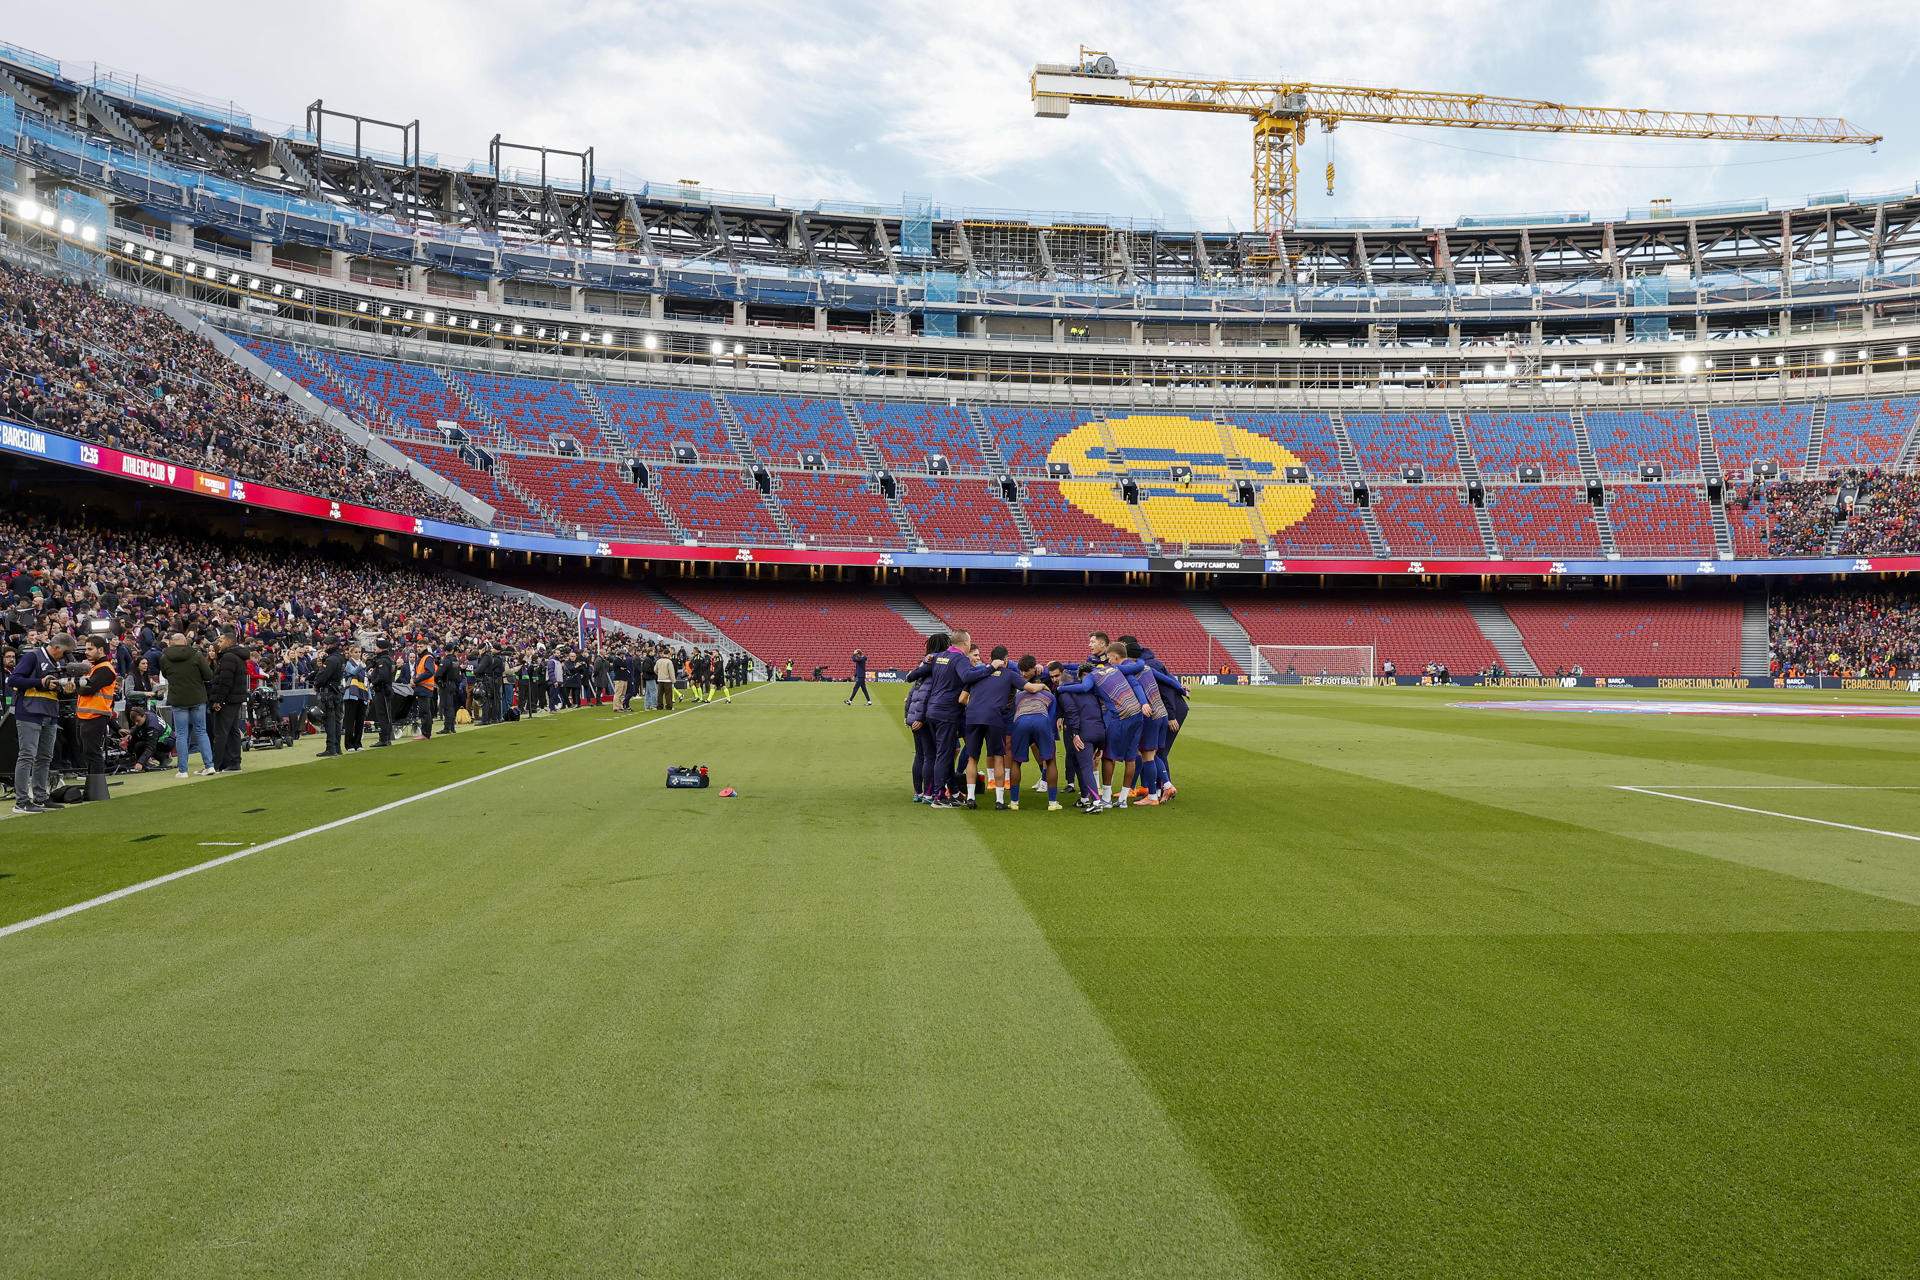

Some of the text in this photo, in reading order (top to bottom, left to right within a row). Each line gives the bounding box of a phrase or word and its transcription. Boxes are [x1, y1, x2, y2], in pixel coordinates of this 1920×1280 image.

[2, 424, 46, 454] BARCELONA
[122, 455, 166, 481] ATHLETIC CLUB
[1183, 561, 1208, 569] SPOTIFY
[1658, 678, 1749, 689] FCBARCELONA.COM/VIP
